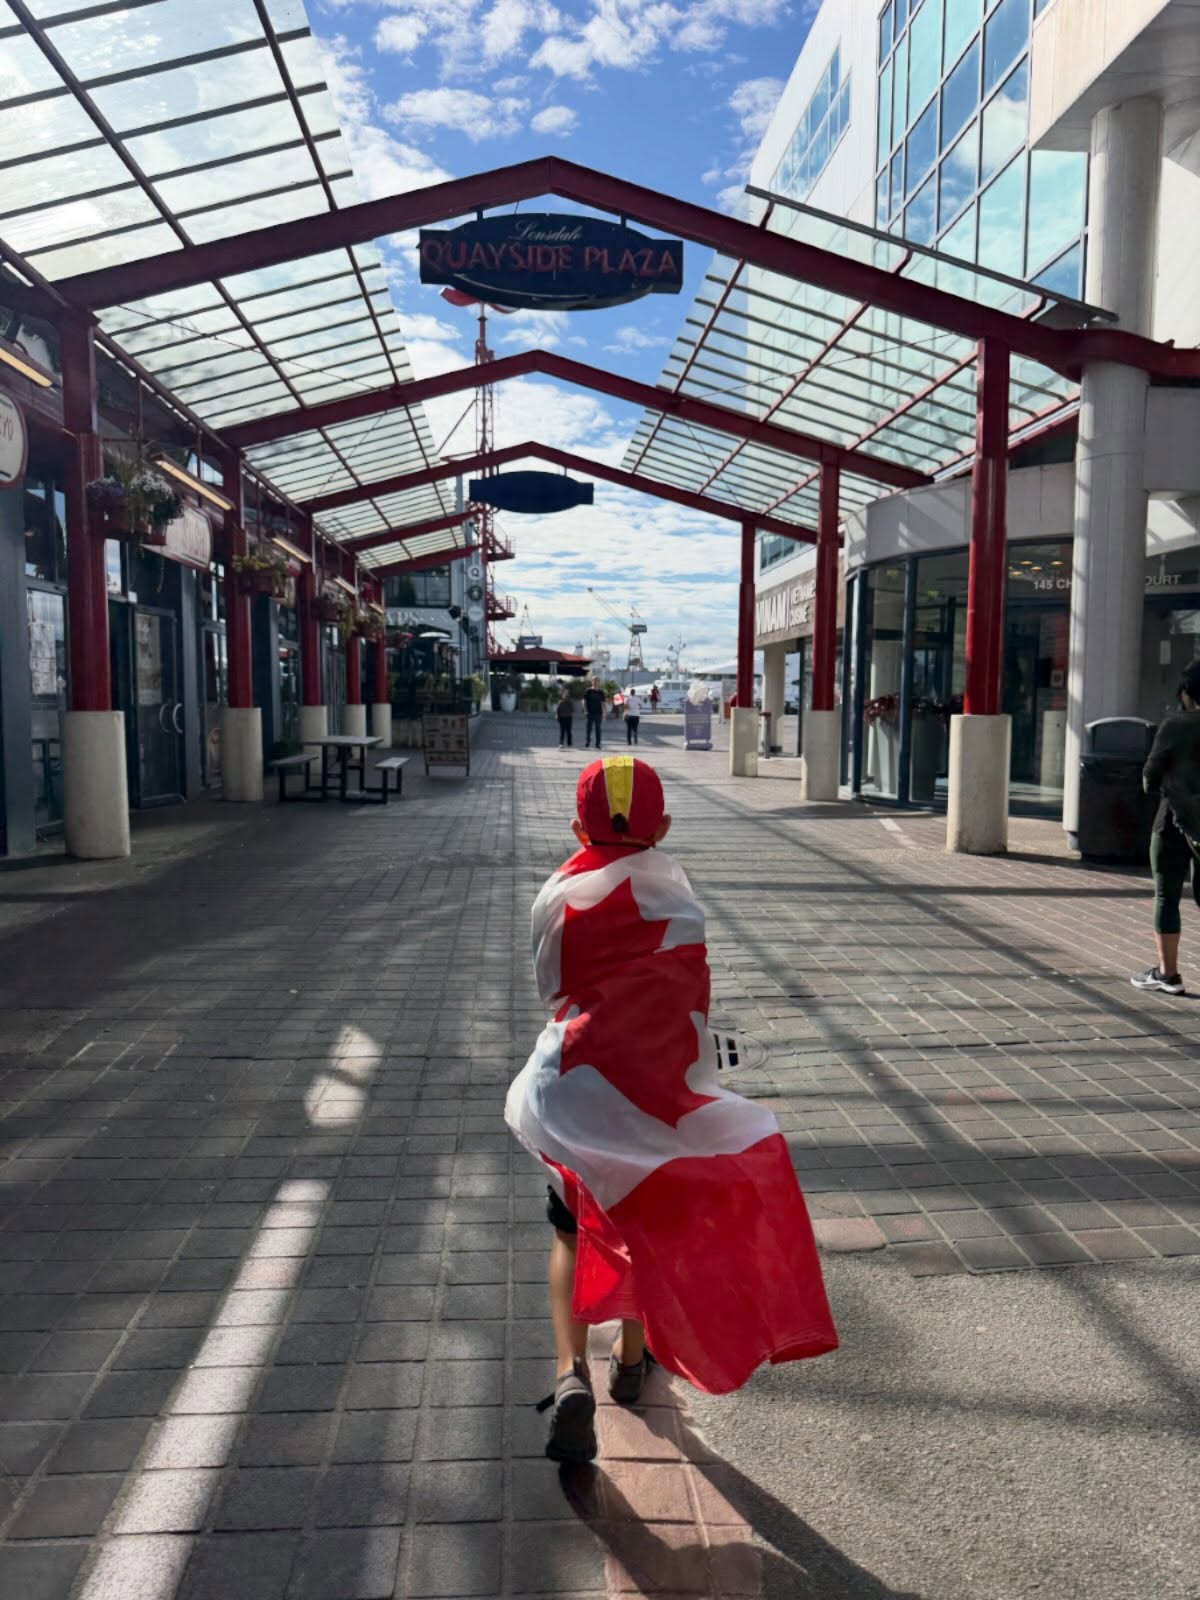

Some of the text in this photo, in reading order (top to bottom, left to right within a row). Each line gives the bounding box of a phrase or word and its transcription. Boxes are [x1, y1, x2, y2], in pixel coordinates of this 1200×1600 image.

[421, 240, 678, 277] QUAYSIDE PLAZA
[1033, 574, 1182, 591] 145 CH OURT
